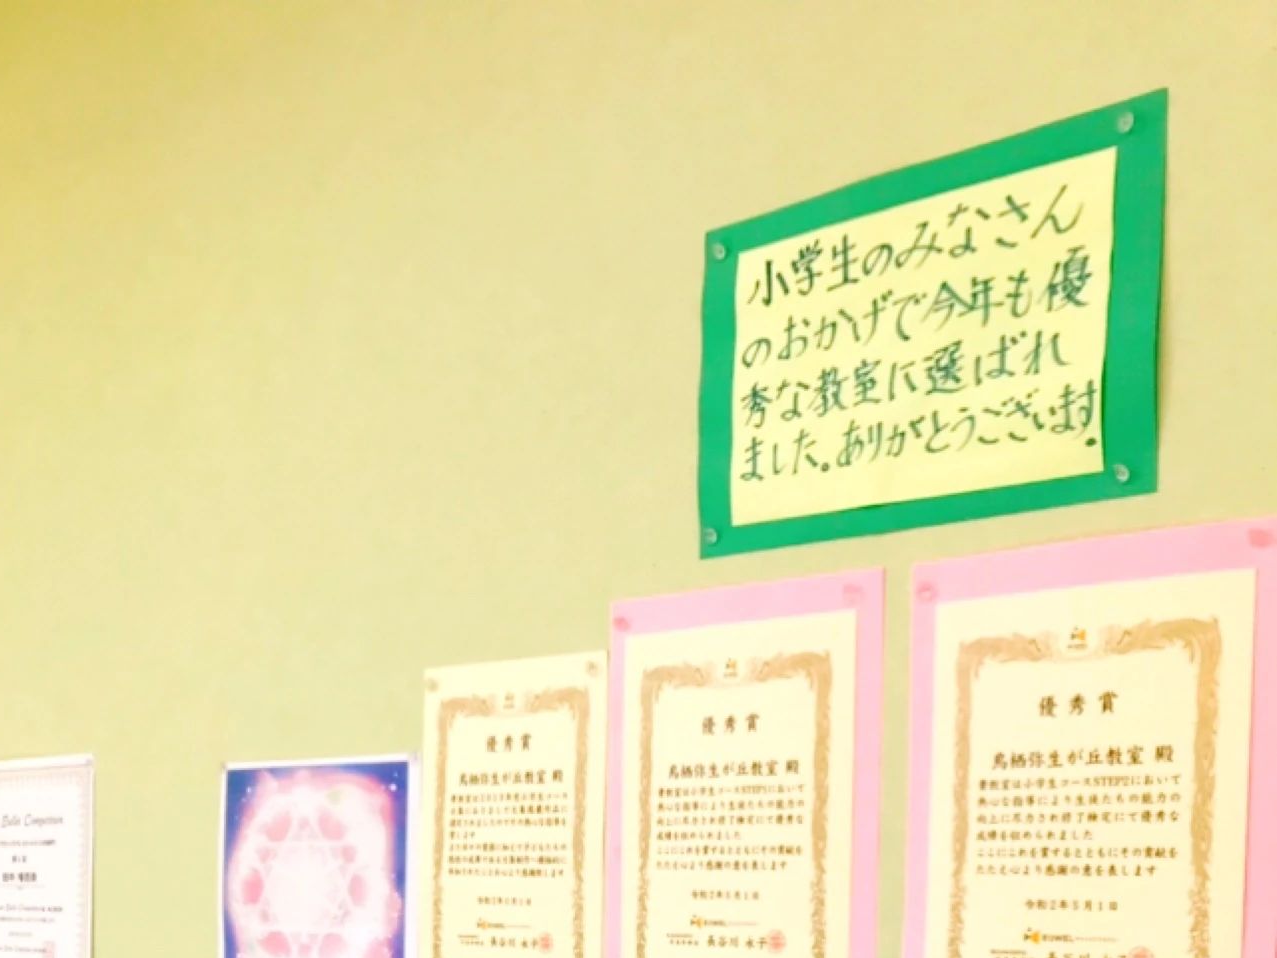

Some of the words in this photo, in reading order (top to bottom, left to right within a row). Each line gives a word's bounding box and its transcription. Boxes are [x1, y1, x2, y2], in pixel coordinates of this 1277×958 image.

[747, 184, 1083, 306] 小学生のみなさん
[741, 245, 1093, 369] のおかげで今年も優
[740, 329, 1071, 429] 秀な教室に選ばれ
[1039, 691, 1118, 717] 優秀賞
